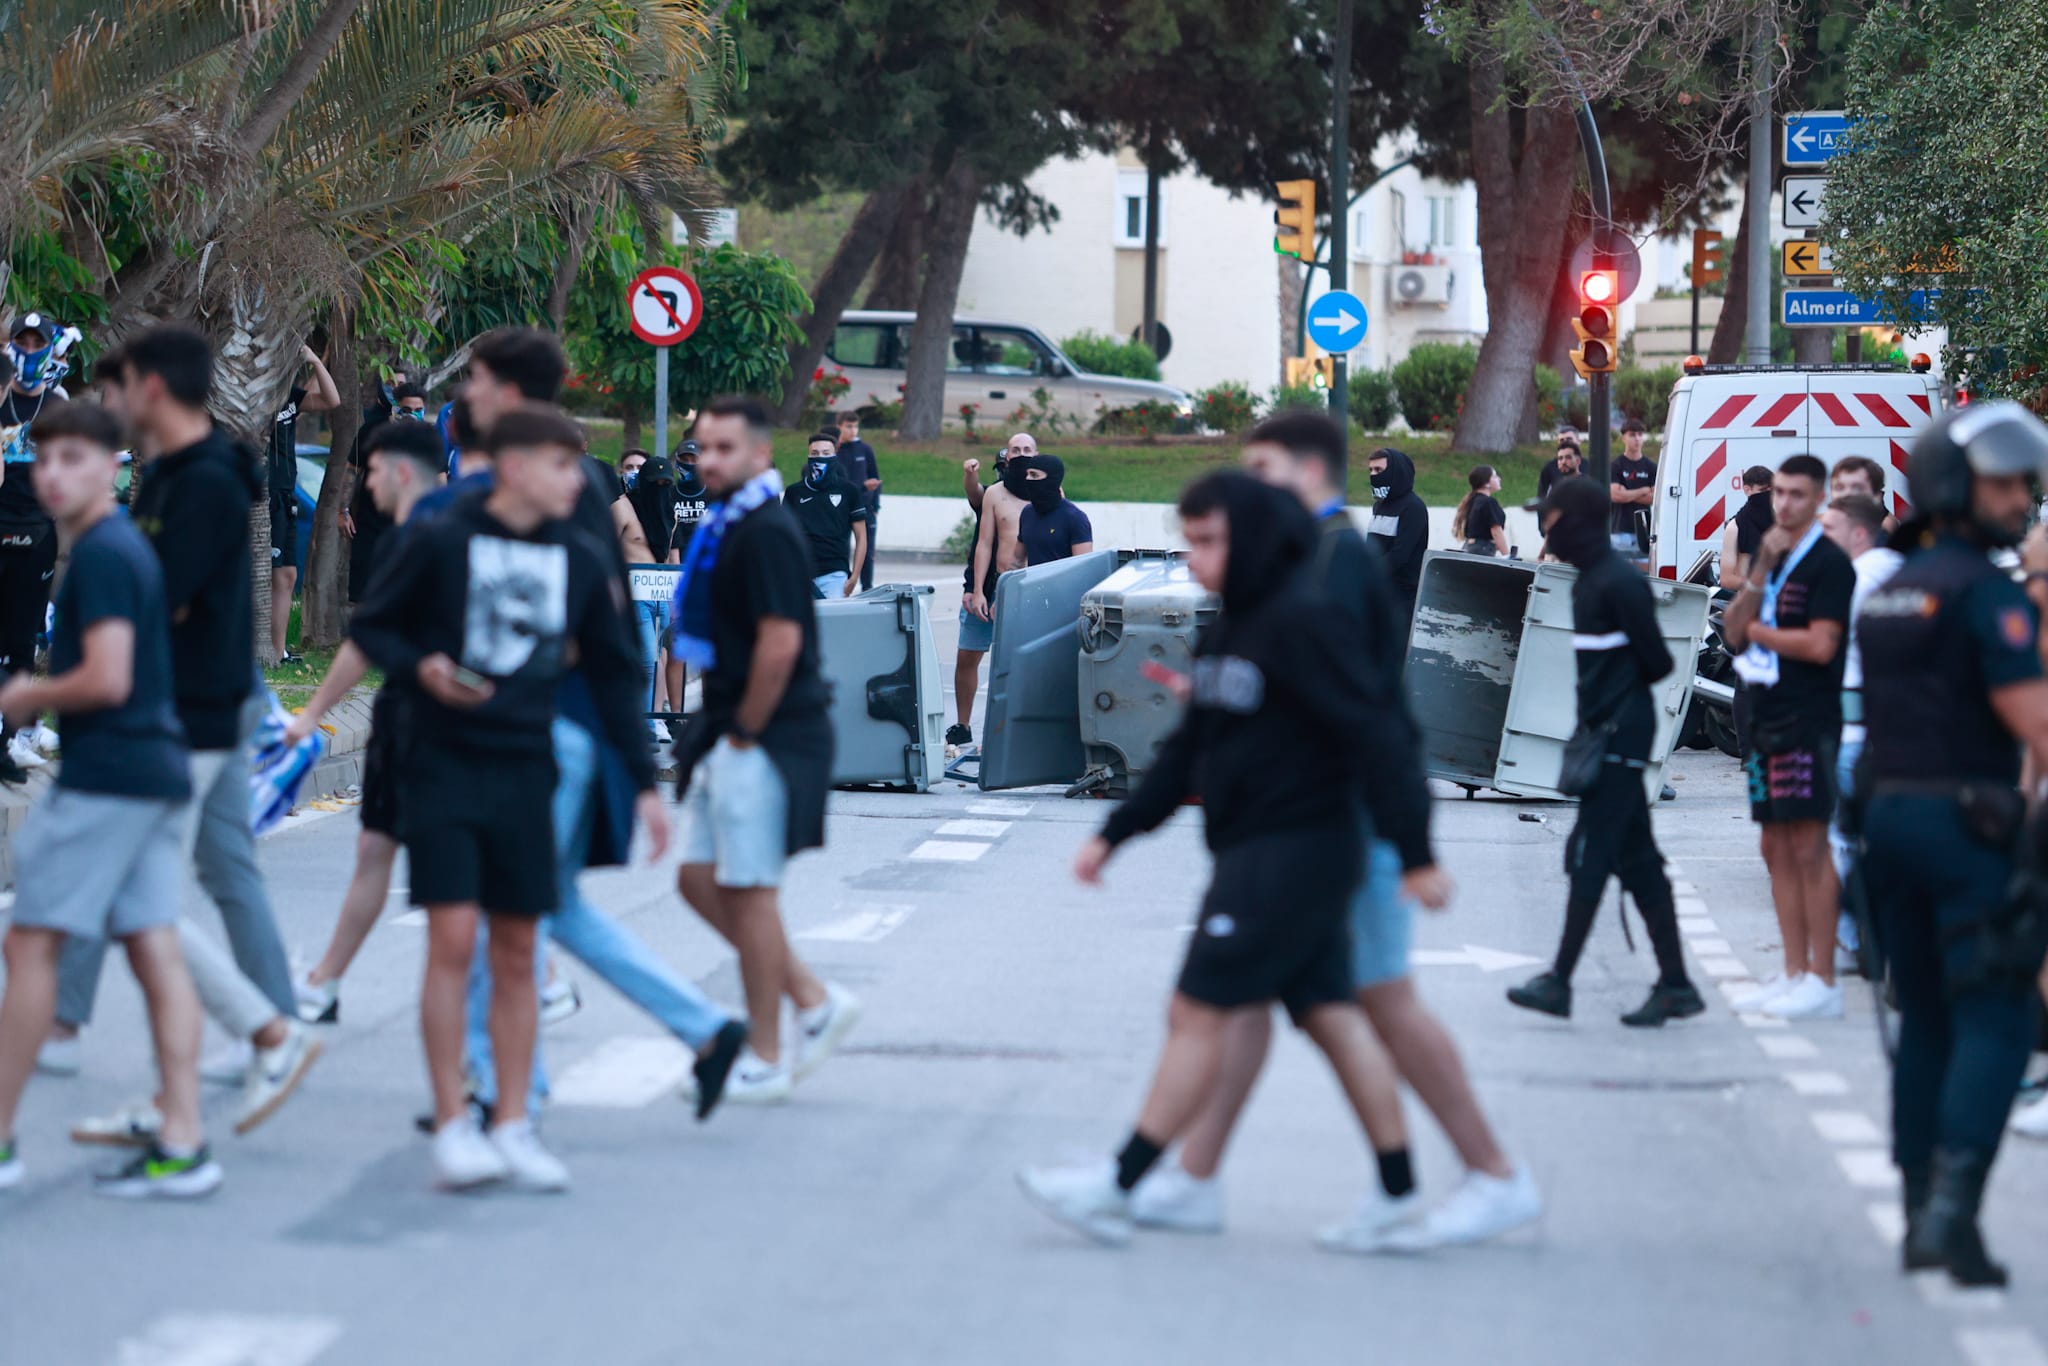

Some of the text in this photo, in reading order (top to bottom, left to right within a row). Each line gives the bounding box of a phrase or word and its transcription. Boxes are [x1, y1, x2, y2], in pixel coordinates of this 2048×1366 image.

[1789, 300, 1860, 315] Almería
[674, 501, 705, 509] ALL IS
[675, 508, 709, 517] RETTY
[2, 535, 33, 545] FILA
[634, 575, 673, 586] POLICIA
[650, 589, 672, 601] MAL
